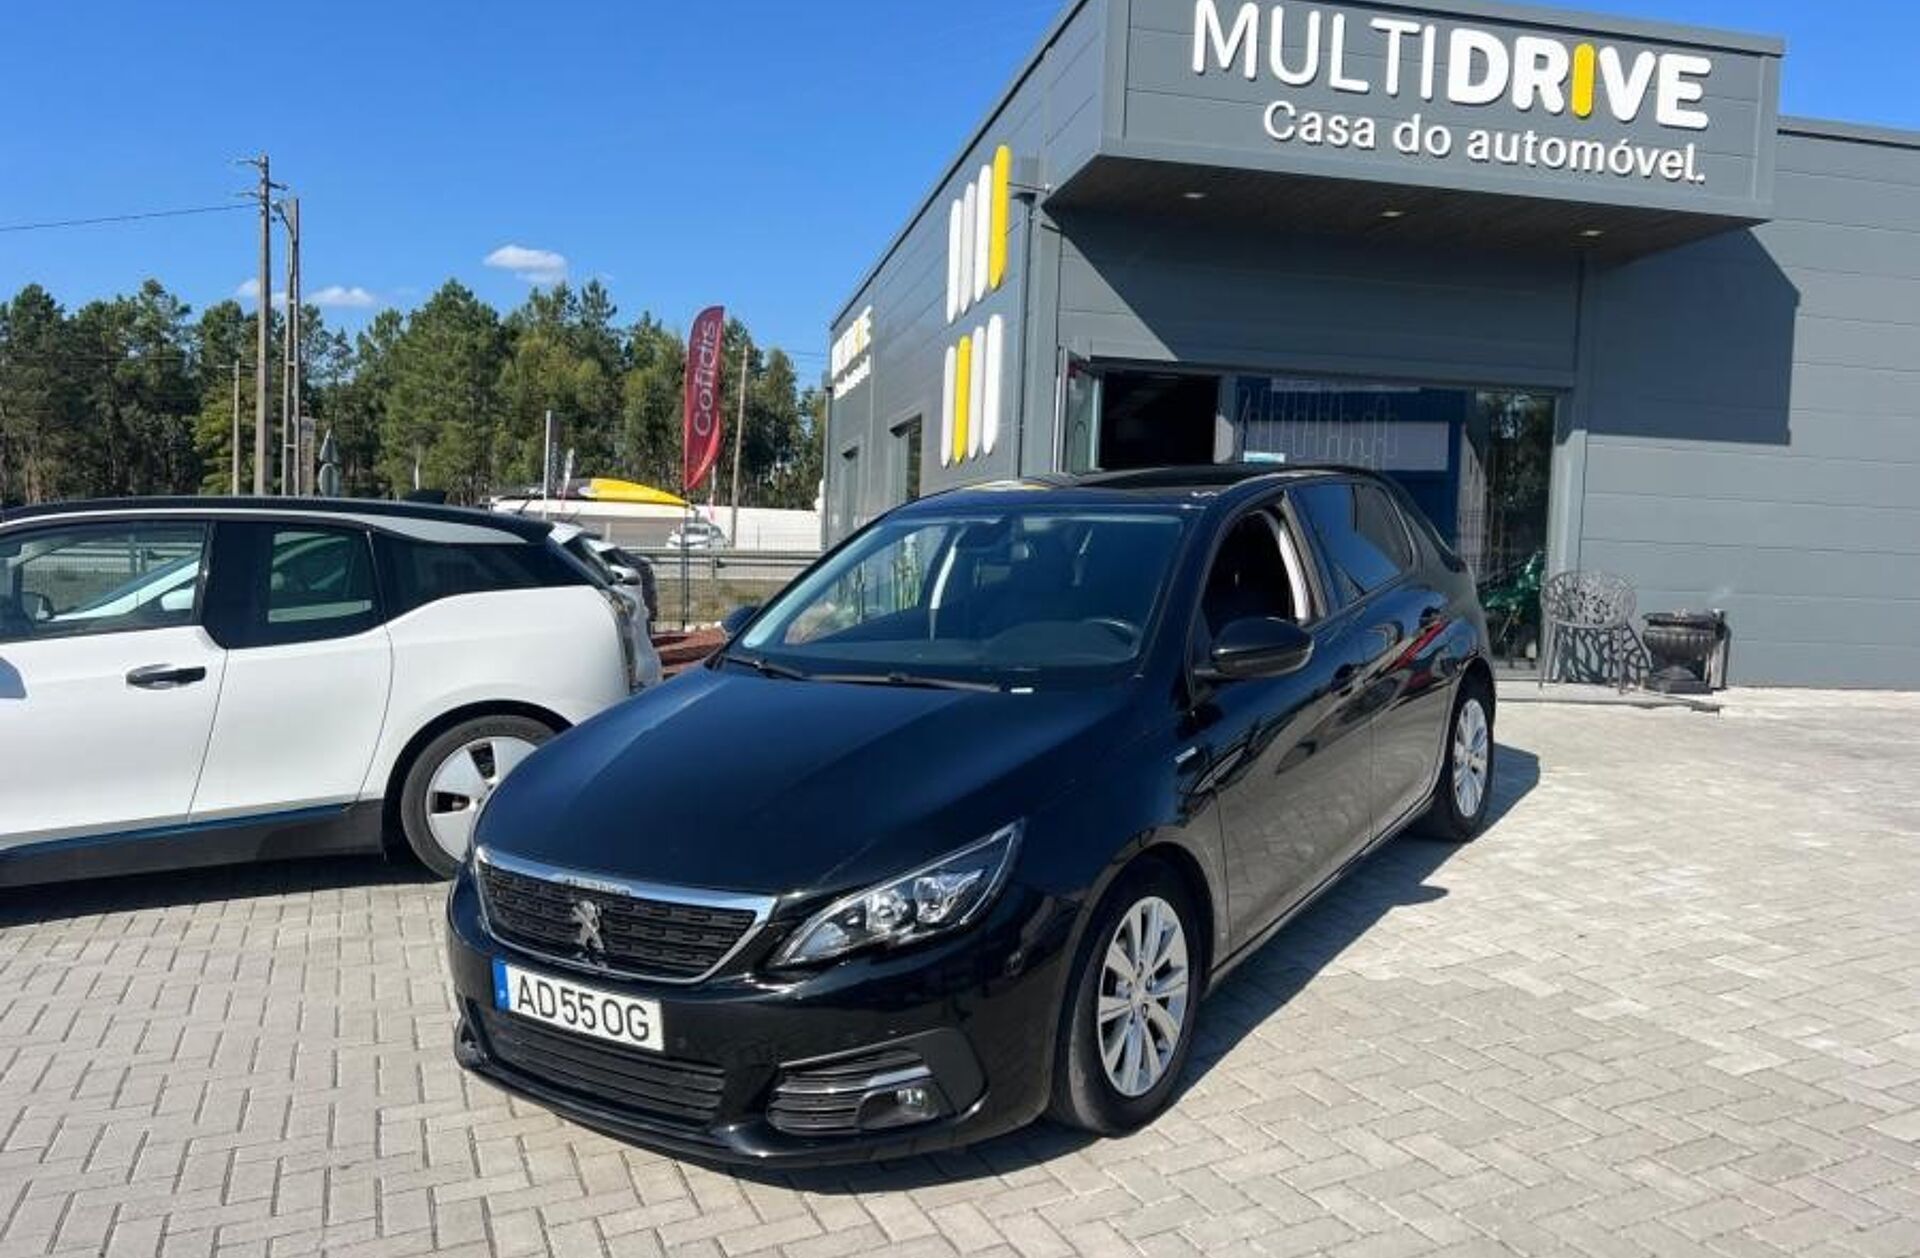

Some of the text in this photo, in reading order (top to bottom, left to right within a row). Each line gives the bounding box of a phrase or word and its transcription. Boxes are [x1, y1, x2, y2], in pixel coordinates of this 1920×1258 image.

[1192, 0, 1712, 130] MULTIDRIVE
[1263, 100, 1706, 183] Casa do automóvel.
[694, 320, 717, 437] Cofidis
